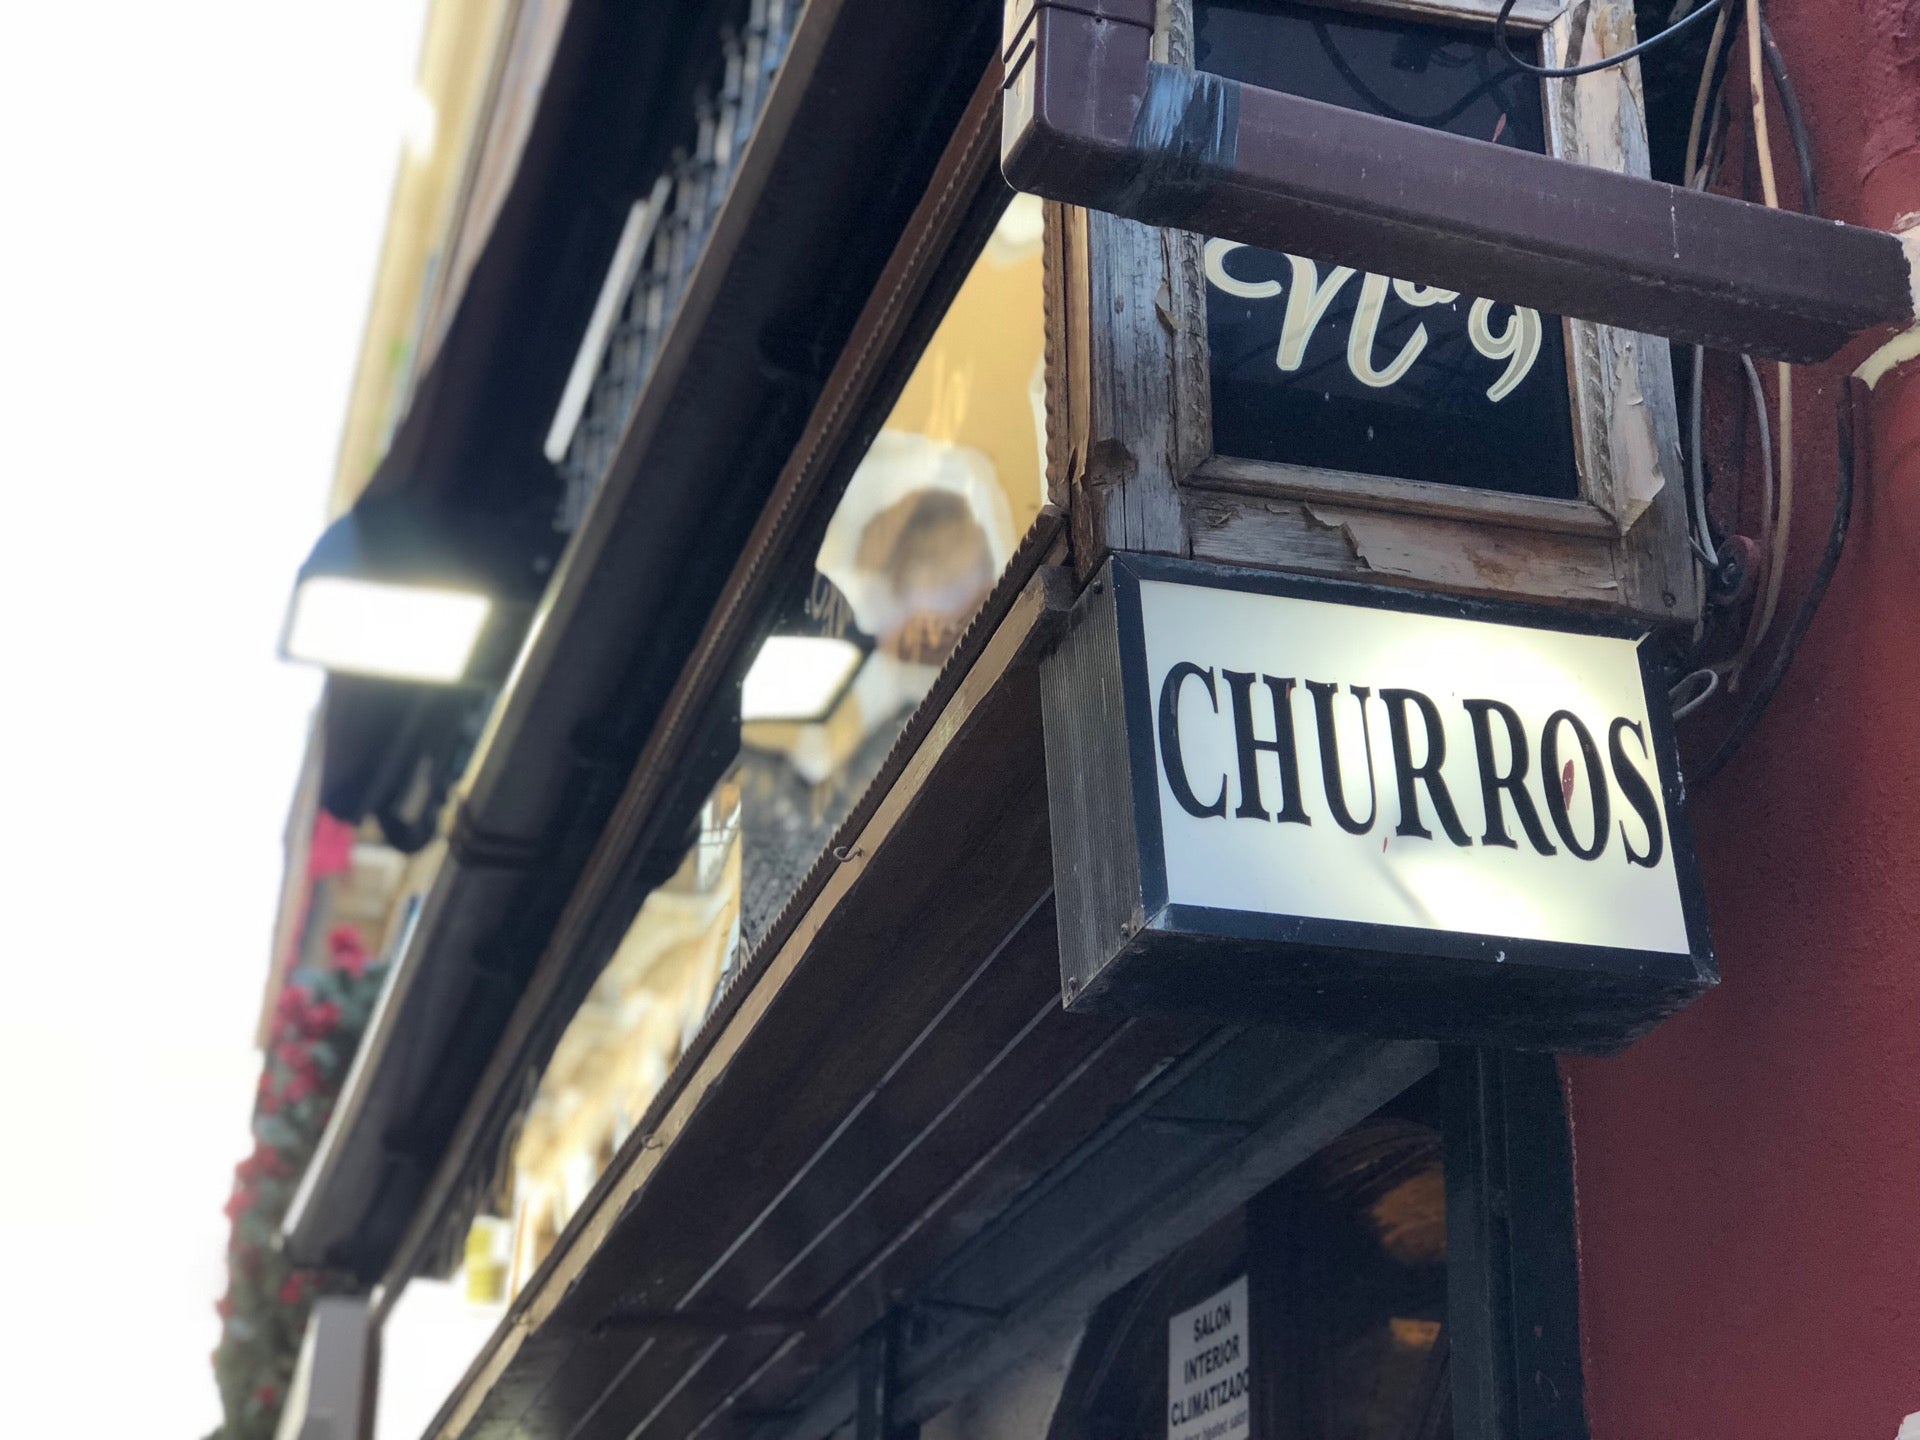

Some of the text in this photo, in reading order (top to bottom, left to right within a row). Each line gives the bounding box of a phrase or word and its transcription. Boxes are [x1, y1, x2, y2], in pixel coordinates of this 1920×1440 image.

[1158, 661, 1664, 868] CHURROS
[1193, 1300, 1232, 1342] SALON
[1183, 1333, 1240, 1385] INTERIOR
[1171, 1367, 1249, 1426] CLIMATIZADO
